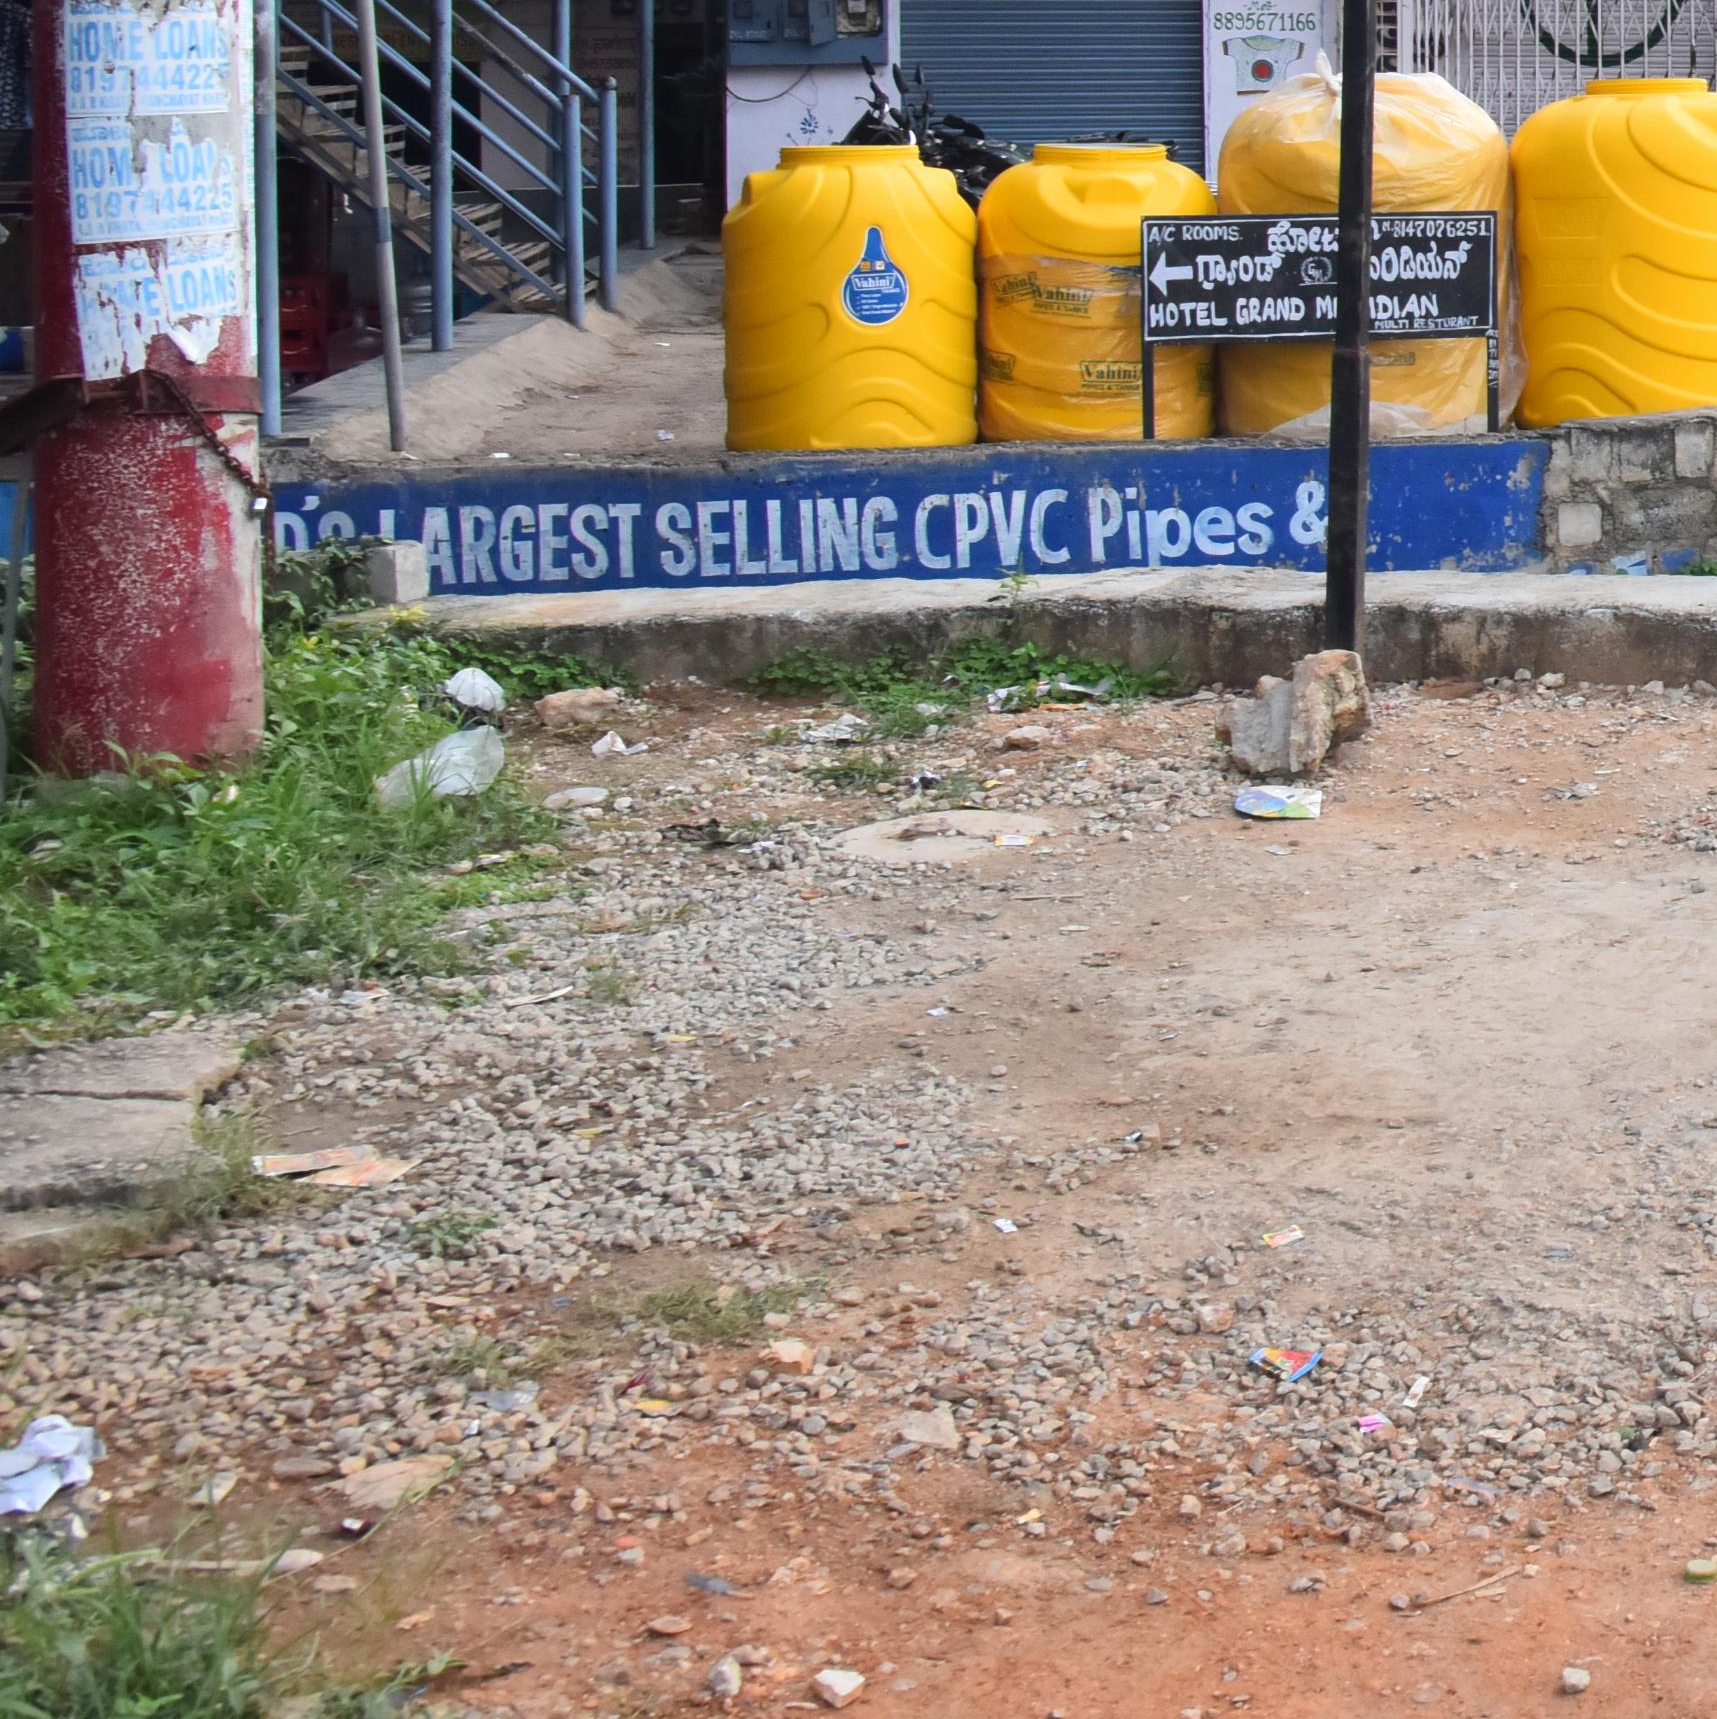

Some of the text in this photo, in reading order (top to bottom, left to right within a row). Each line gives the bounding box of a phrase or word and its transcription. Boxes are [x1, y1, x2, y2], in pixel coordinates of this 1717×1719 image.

[1214, 11, 1317, 32] 8895671166
[72, 146, 134, 189] HOM
[1149, 225, 1177, 244] A/C
[854, 275, 891, 289] Vahini
[1149, 293, 1439, 327] HOTEL GRAND MIDIAN
[1375, 315, 1479, 330] MULTI RESTURANT
[1084, 363, 1138, 381] Vahini
[655, 495, 898, 578] SELLING
[914, 488, 1070, 569] CPVC
[1089, 485, 1275, 569] Pipes
